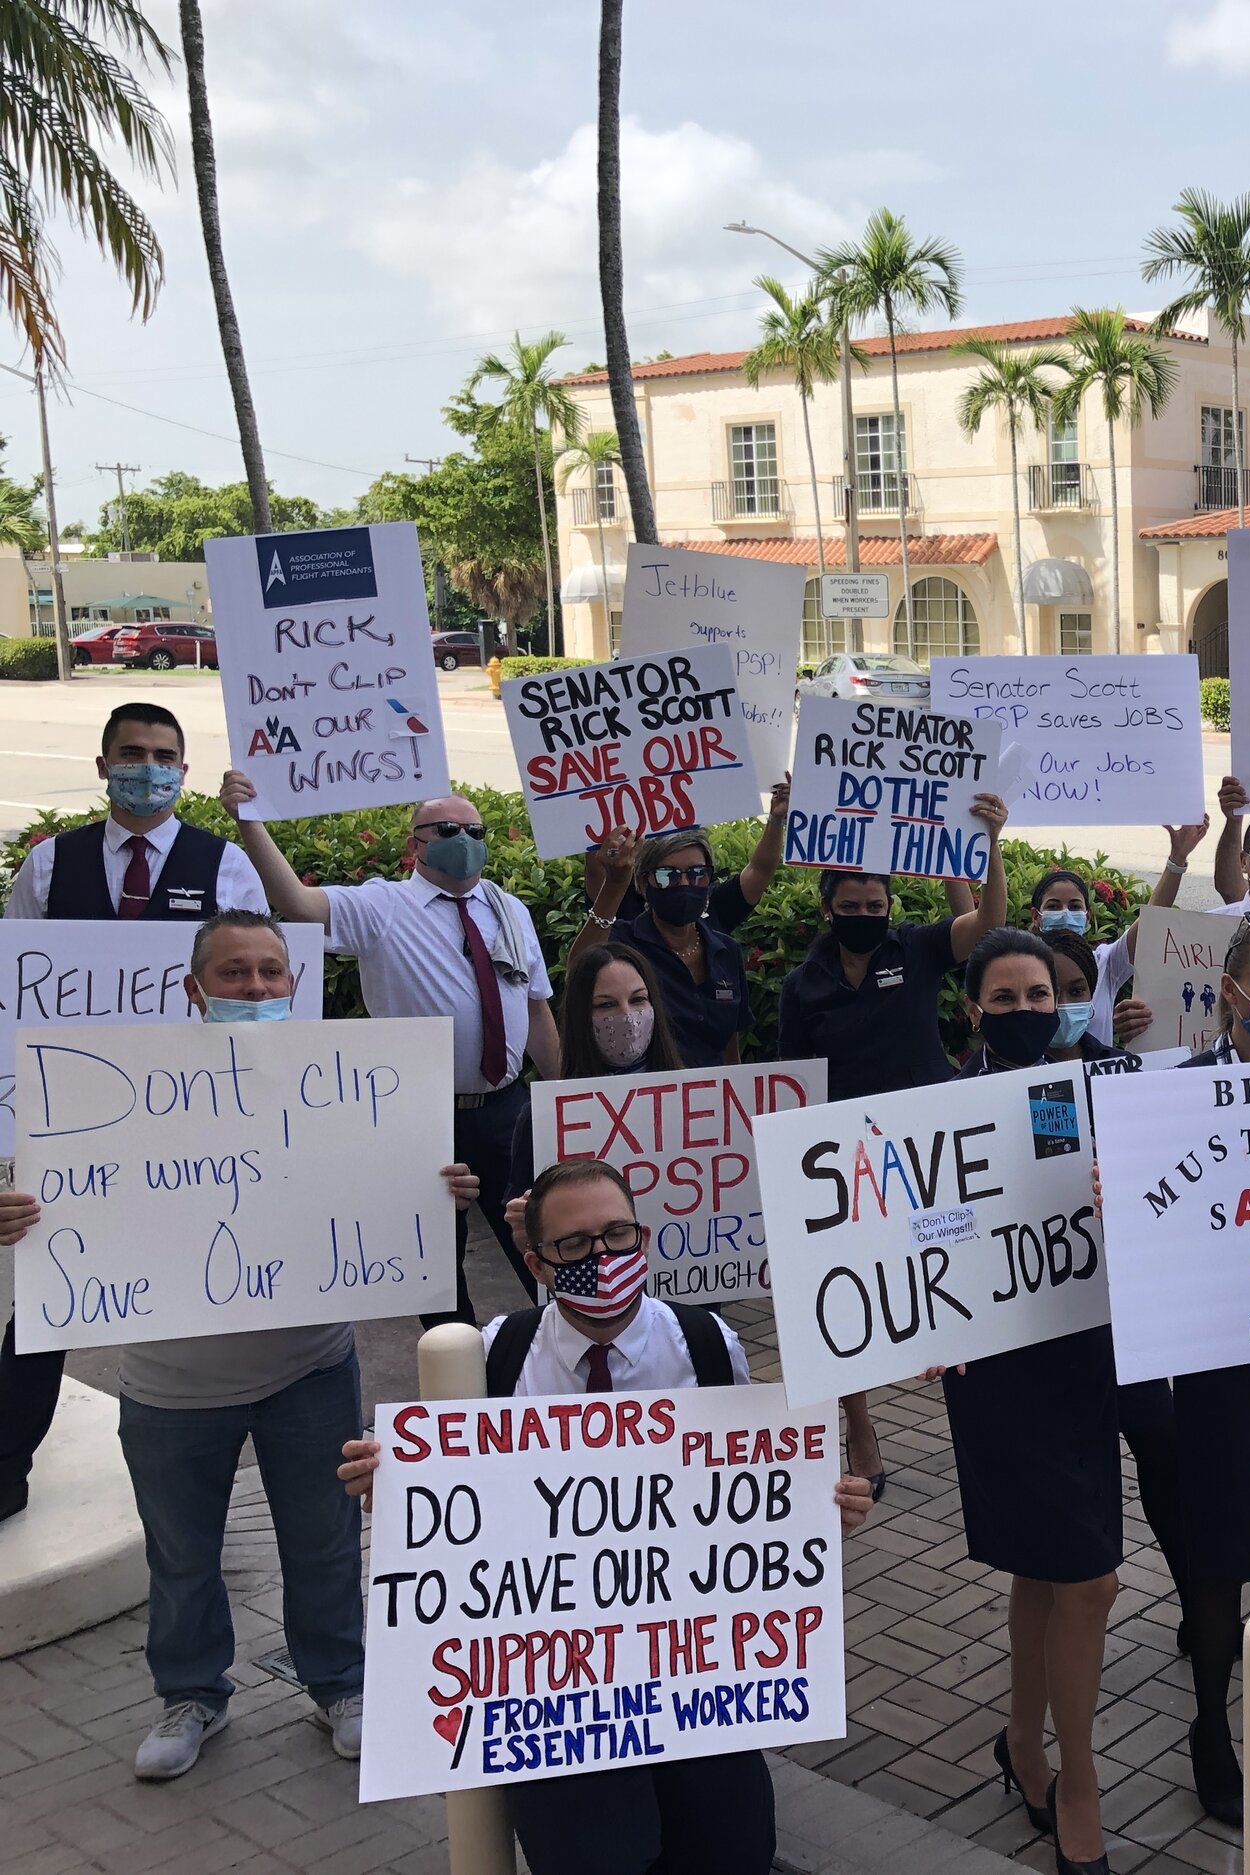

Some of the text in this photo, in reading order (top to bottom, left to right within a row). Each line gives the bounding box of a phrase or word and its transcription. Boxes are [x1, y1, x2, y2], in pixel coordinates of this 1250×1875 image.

[289, 550, 356, 563] ASSOCIATION OF
[290, 561, 350, 572] PROFESSIONAL
[291, 566, 373, 581] FLIGHT ATTENDANTS
[641, 563, 738, 602] Jetblue
[275, 614, 396, 653] RICK,
[328, 661, 407, 691] CLIP
[518, 656, 700, 719] SENATOR
[736, 650, 783, 676] PSP!
[949, 667, 1143, 699] Senator Scott
[313, 707, 376, 738] OUR
[539, 688, 736, 753] RICK SCOTT
[851, 702, 975, 752] SENATOR
[974, 704, 1184, 731] PSP saves JOBS
[526, 726, 738, 794] SAVE OUR
[815, 733, 987, 782] RICK SCOTT
[1040, 751, 1155, 775] Our Jobs
[579, 772, 697, 844] JOBS
[839, 771, 950, 822] DO THE
[786, 810, 988, 881] RIGHT THING
[1164, 927, 1224, 969] AIRL
[16, 951, 185, 1020] RELIEF
[26, 1036, 254, 1137] Dont
[300, 1051, 400, 1127] clip
[555, 1073, 807, 1162] EXTEND
[1033, 1105, 1068, 1124] POWER
[1048, 1117, 1075, 1133] UNITY
[146, 1110, 290, 1214] wings!
[623, 1152, 750, 1216] PSP
[801, 1121, 1004, 1235] SAAVE
[657, 1214, 742, 1261] OUR
[918, 1221, 973, 1243] Our Wings!!!
[922, 1211, 966, 1229] Don't Clip
[42, 1228, 153, 1328] Save
[319, 1213, 429, 1293] Jobs!
[816, 1205, 1098, 1359] OUR JOBS
[392, 1398, 827, 1468] SENATORS PLEASE
[406, 1470, 792, 1550] DO YOUR JOB
[373, 1537, 828, 1627] TO SAVE OUR JOBS
[427, 1605, 823, 1707] SUPPORT THE PSP
[483, 1676, 810, 1737] FRONTLINE WORKERS
[482, 1718, 666, 1774] ESSENTIAL
